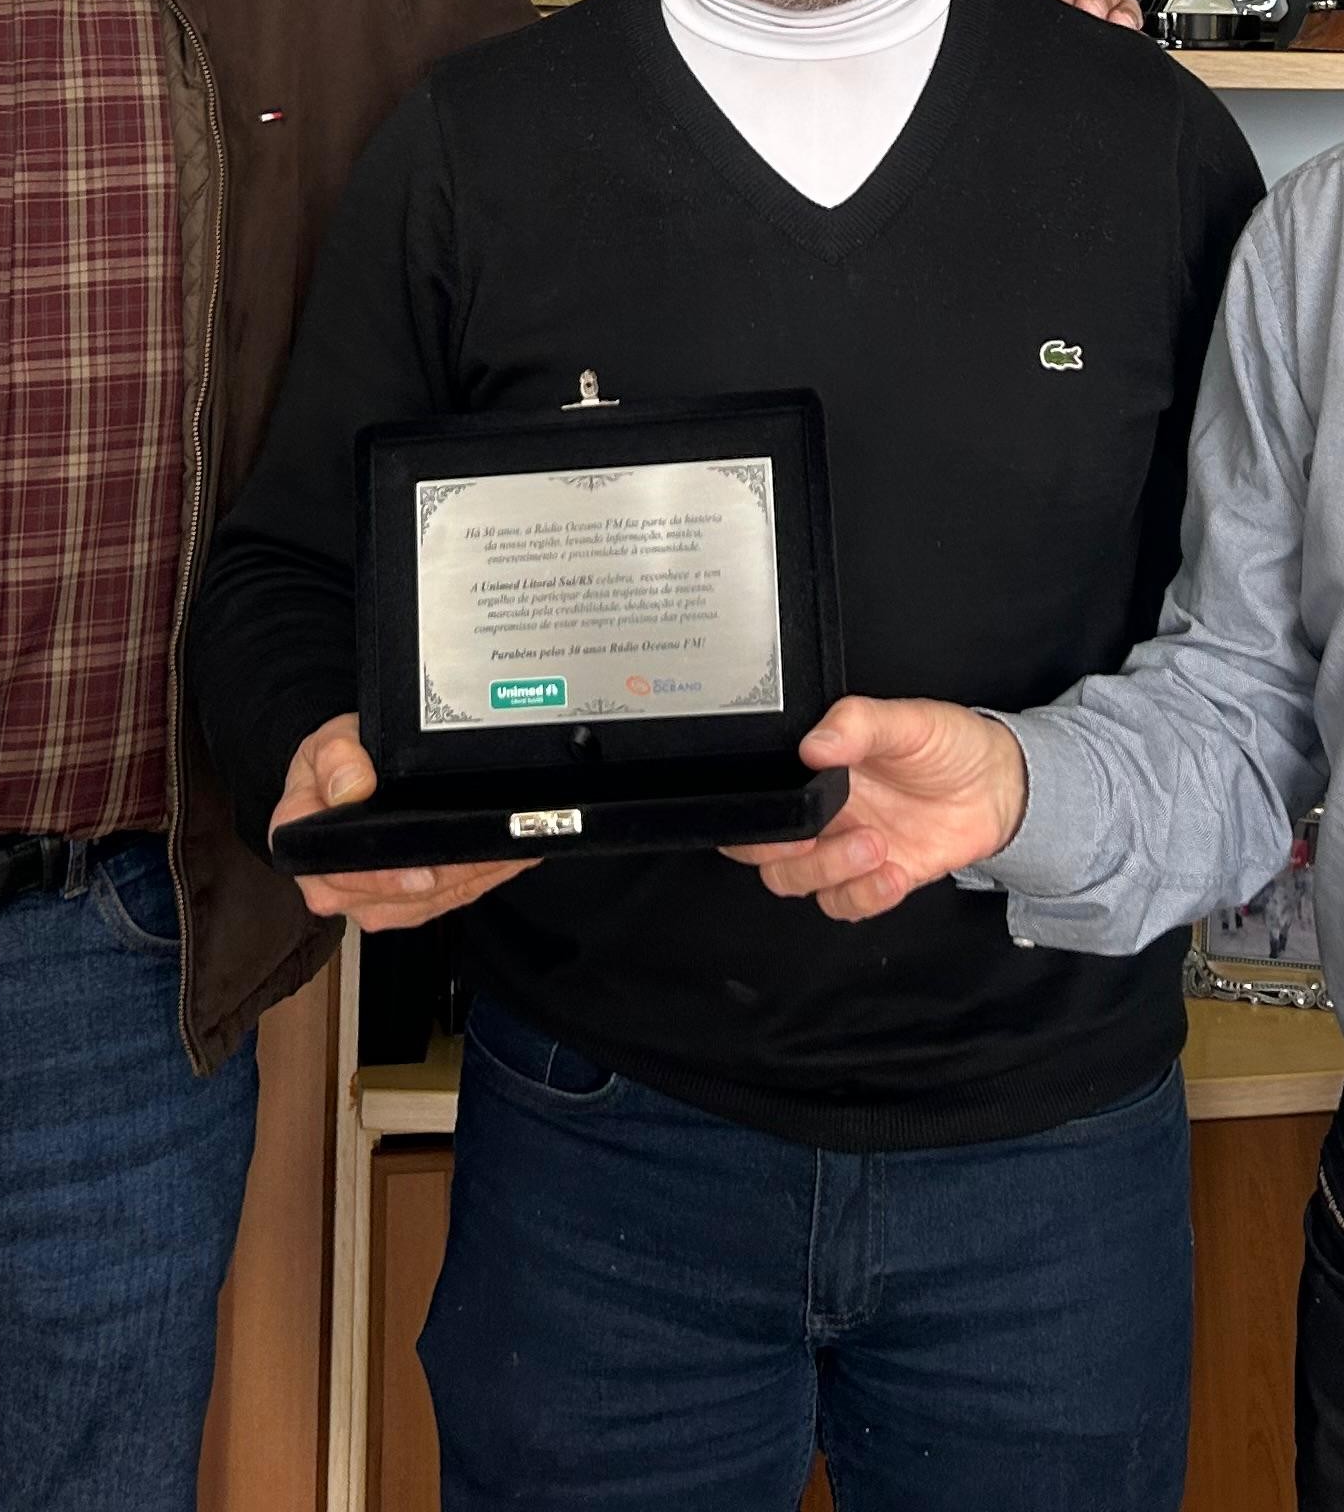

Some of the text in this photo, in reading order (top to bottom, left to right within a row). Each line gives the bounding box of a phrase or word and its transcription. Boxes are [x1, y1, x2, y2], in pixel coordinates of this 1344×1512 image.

[606, 518, 623, 528] FM
[641, 517, 667, 529] parte
[500, 541, 527, 549] nossa
[482, 580, 520, 591] Unimed
[523, 577, 556, 588] Litoral
[559, 575, 593, 586] Sul/RS
[478, 593, 515, 607] orgulho
[532, 591, 580, 603] participar
[488, 606, 529, 618] marcada
[532, 605, 553, 618] pela
[491, 647, 537, 659] Parabéns
[540, 645, 565, 659] pelos
[584, 645, 606, 653] anos
[611, 641, 639, 652] Rádio
[642, 639, 680, 650] Oceano
[497, 683, 544, 699] Unimed
